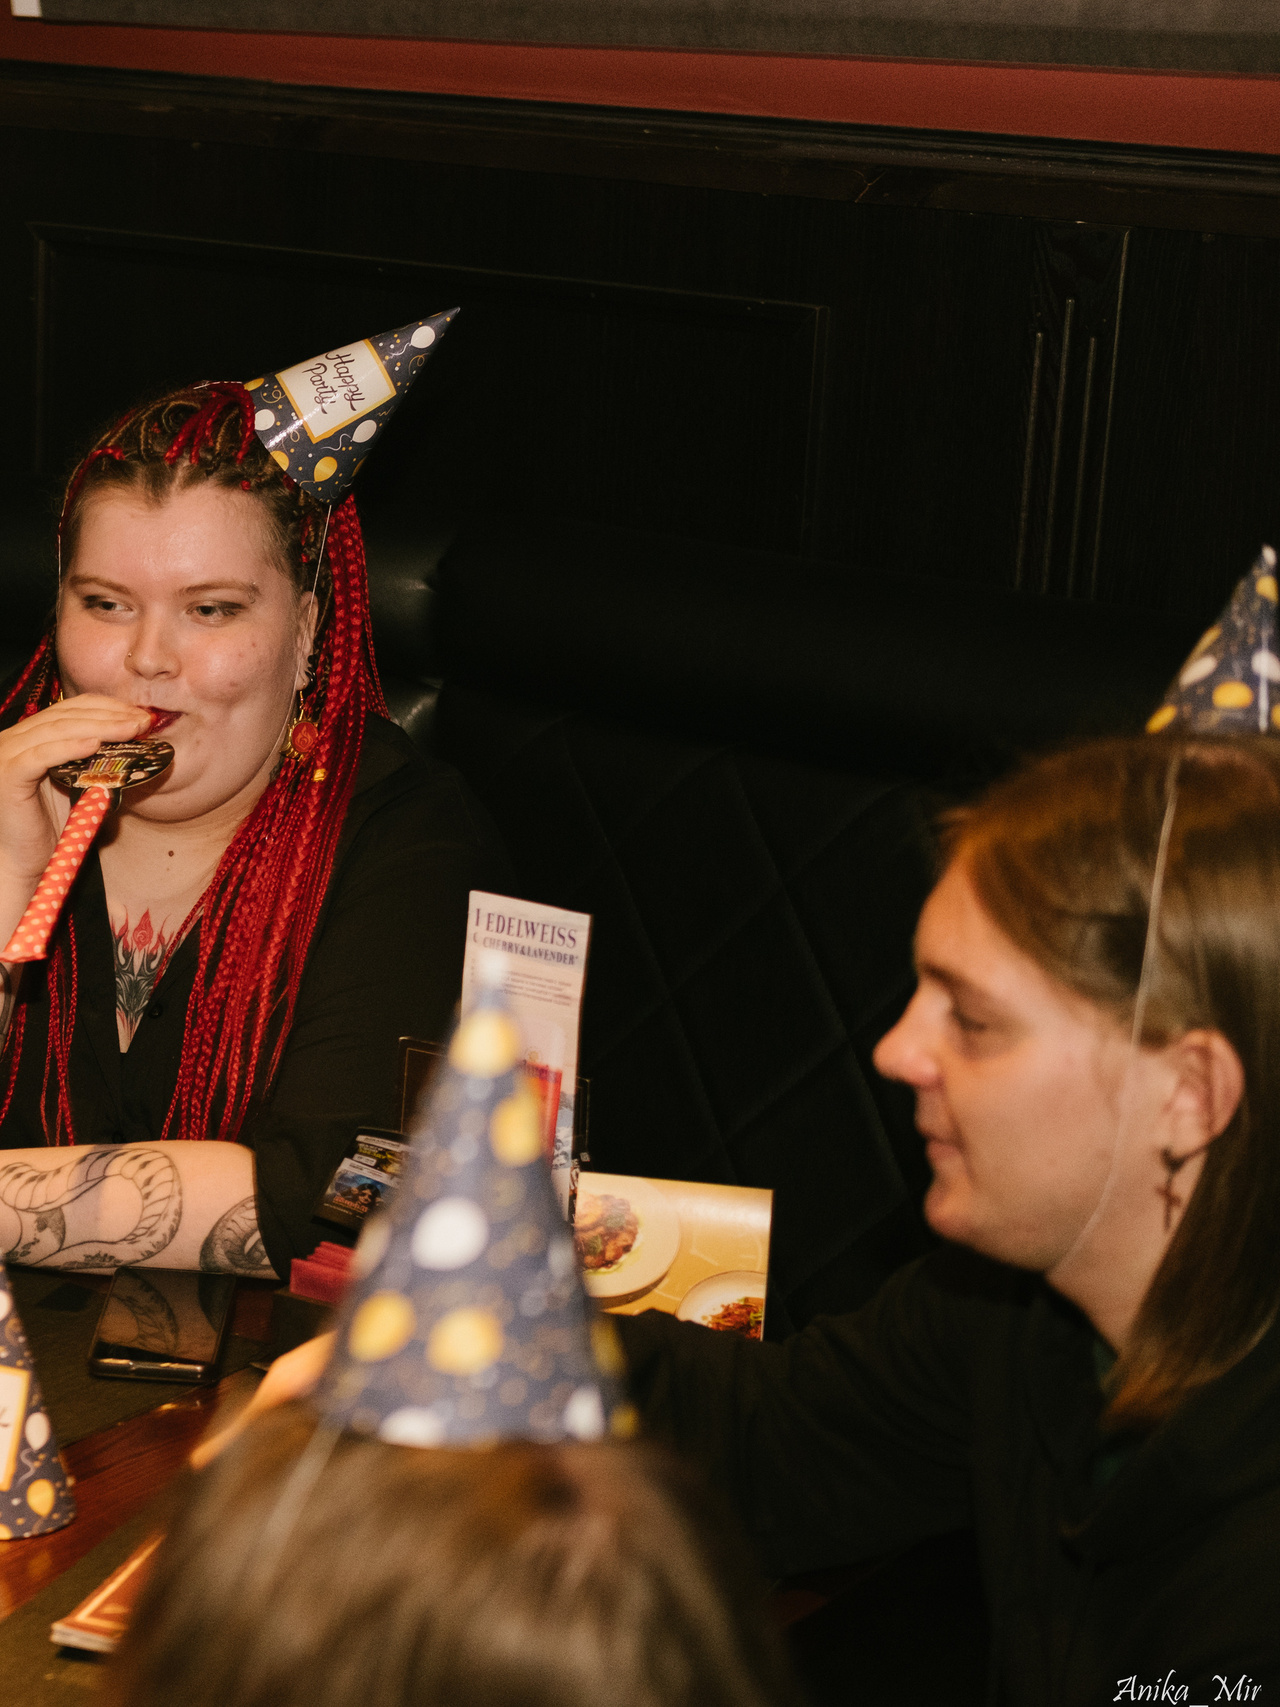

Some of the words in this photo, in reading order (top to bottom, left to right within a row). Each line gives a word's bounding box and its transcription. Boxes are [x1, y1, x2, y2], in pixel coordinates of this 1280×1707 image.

[301, 362, 338, 415] Party
[324, 352, 366, 412] Happy
[485, 911, 579, 949] EDELWEISS
